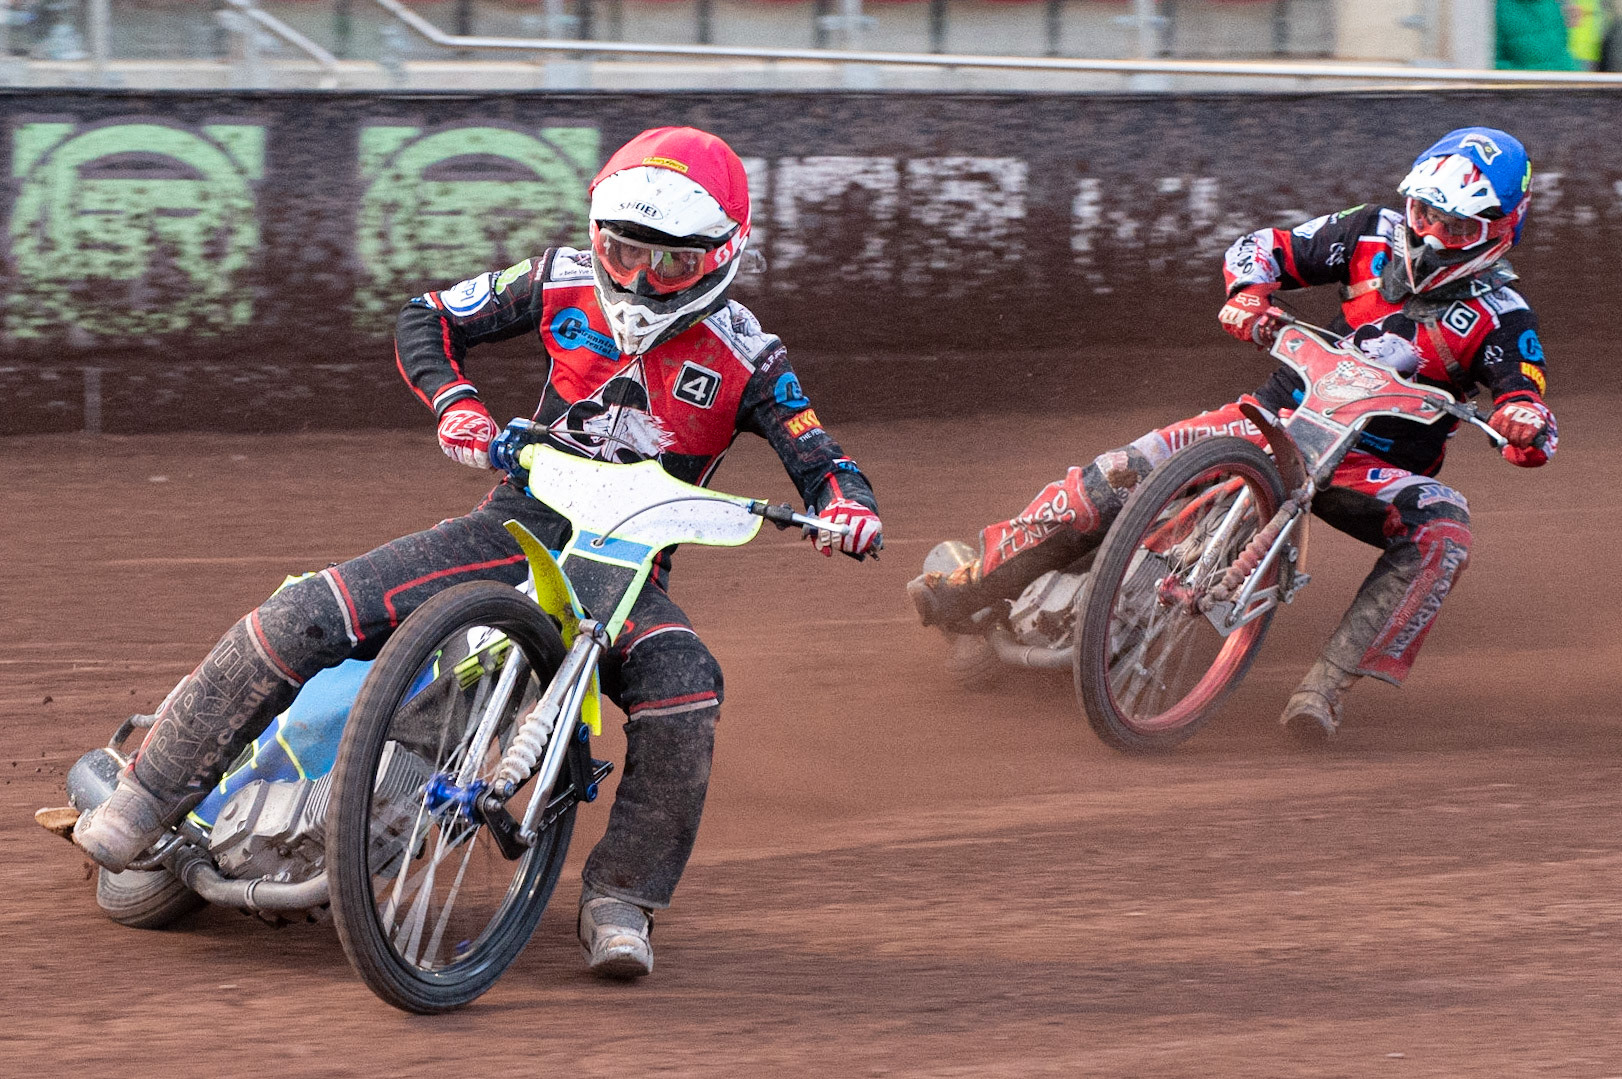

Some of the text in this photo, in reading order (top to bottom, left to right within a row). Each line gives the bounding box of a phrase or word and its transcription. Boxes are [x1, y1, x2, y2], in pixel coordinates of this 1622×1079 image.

[618, 201, 658, 218] SHOEI
[1450, 307, 1474, 330] 6
[681, 374, 706, 401] 4
